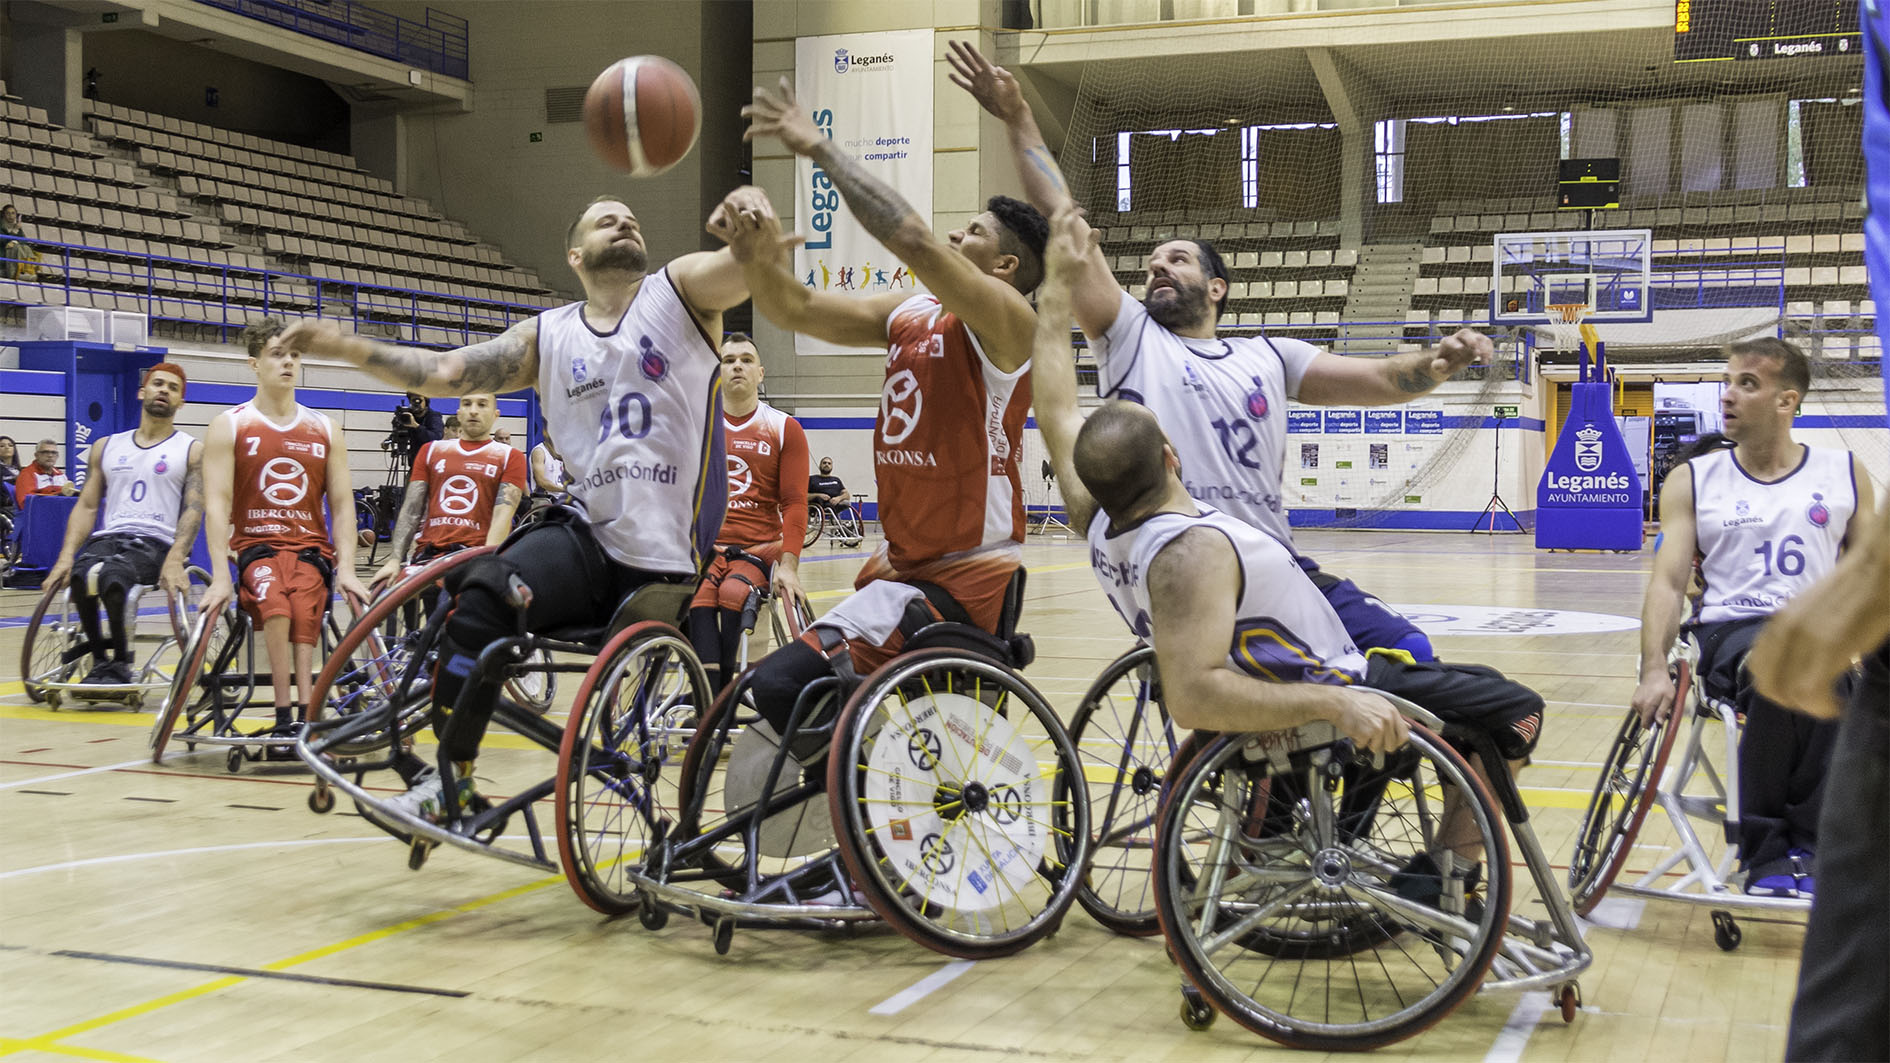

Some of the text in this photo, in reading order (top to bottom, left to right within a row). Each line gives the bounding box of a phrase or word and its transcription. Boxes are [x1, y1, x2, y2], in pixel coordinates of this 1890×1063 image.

[1774, 41, 1823, 56] Leganés
[851, 53, 894, 66] Leganés
[875, 136, 910, 147] deporte
[864, 151, 908, 161] compartir
[804, 108, 839, 250] Legas
[566, 378, 606, 399] Leganés
[246, 437, 260, 456] 7
[1211, 417, 1261, 470] 12
[434, 459, 446, 474] 4
[580, 460, 678, 493] ndaciónfdi
[1548, 472, 1630, 493] Leganés
[130, 480, 147, 502] 0
[1548, 494, 1630, 503] AYUNTAMIENTO
[248, 508, 312, 520] IBERCONSA
[430, 516, 480, 530] IBERCONSA
[1754, 534, 1806, 577] 16
